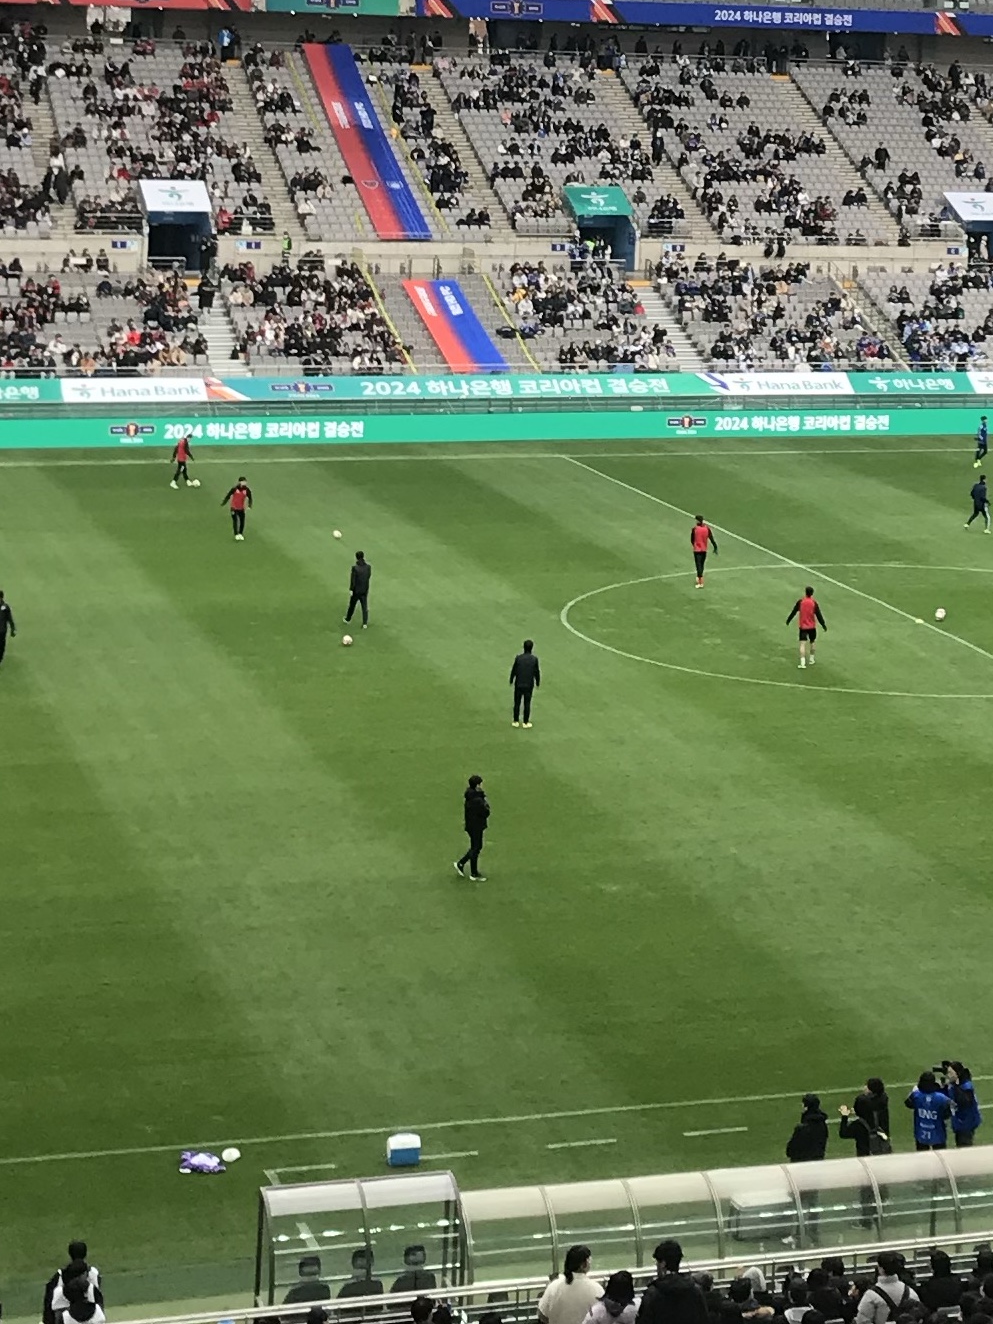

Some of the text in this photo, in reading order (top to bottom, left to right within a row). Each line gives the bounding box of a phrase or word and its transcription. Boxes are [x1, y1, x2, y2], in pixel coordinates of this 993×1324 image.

[715, 9, 853, 26] 2024 하나은행 코리아컵 결승전
[101, 385, 201, 398] Hana Bank
[360, 378, 671, 397] 2024 하나은행 코리아컵 결승전
[757, 379, 845, 391] Hana Bank
[164, 423, 203, 439] 2024
[206, 421, 262, 439] 하나은행
[265, 421, 320, 439] 코리아컵
[324, 421, 364, 438] 결승전
[714, 416, 749, 430] 2024
[751, 415, 800, 431] 하나은행
[803, 415, 851, 431] 코리아컵
[854, 414, 890, 430] 결승전
